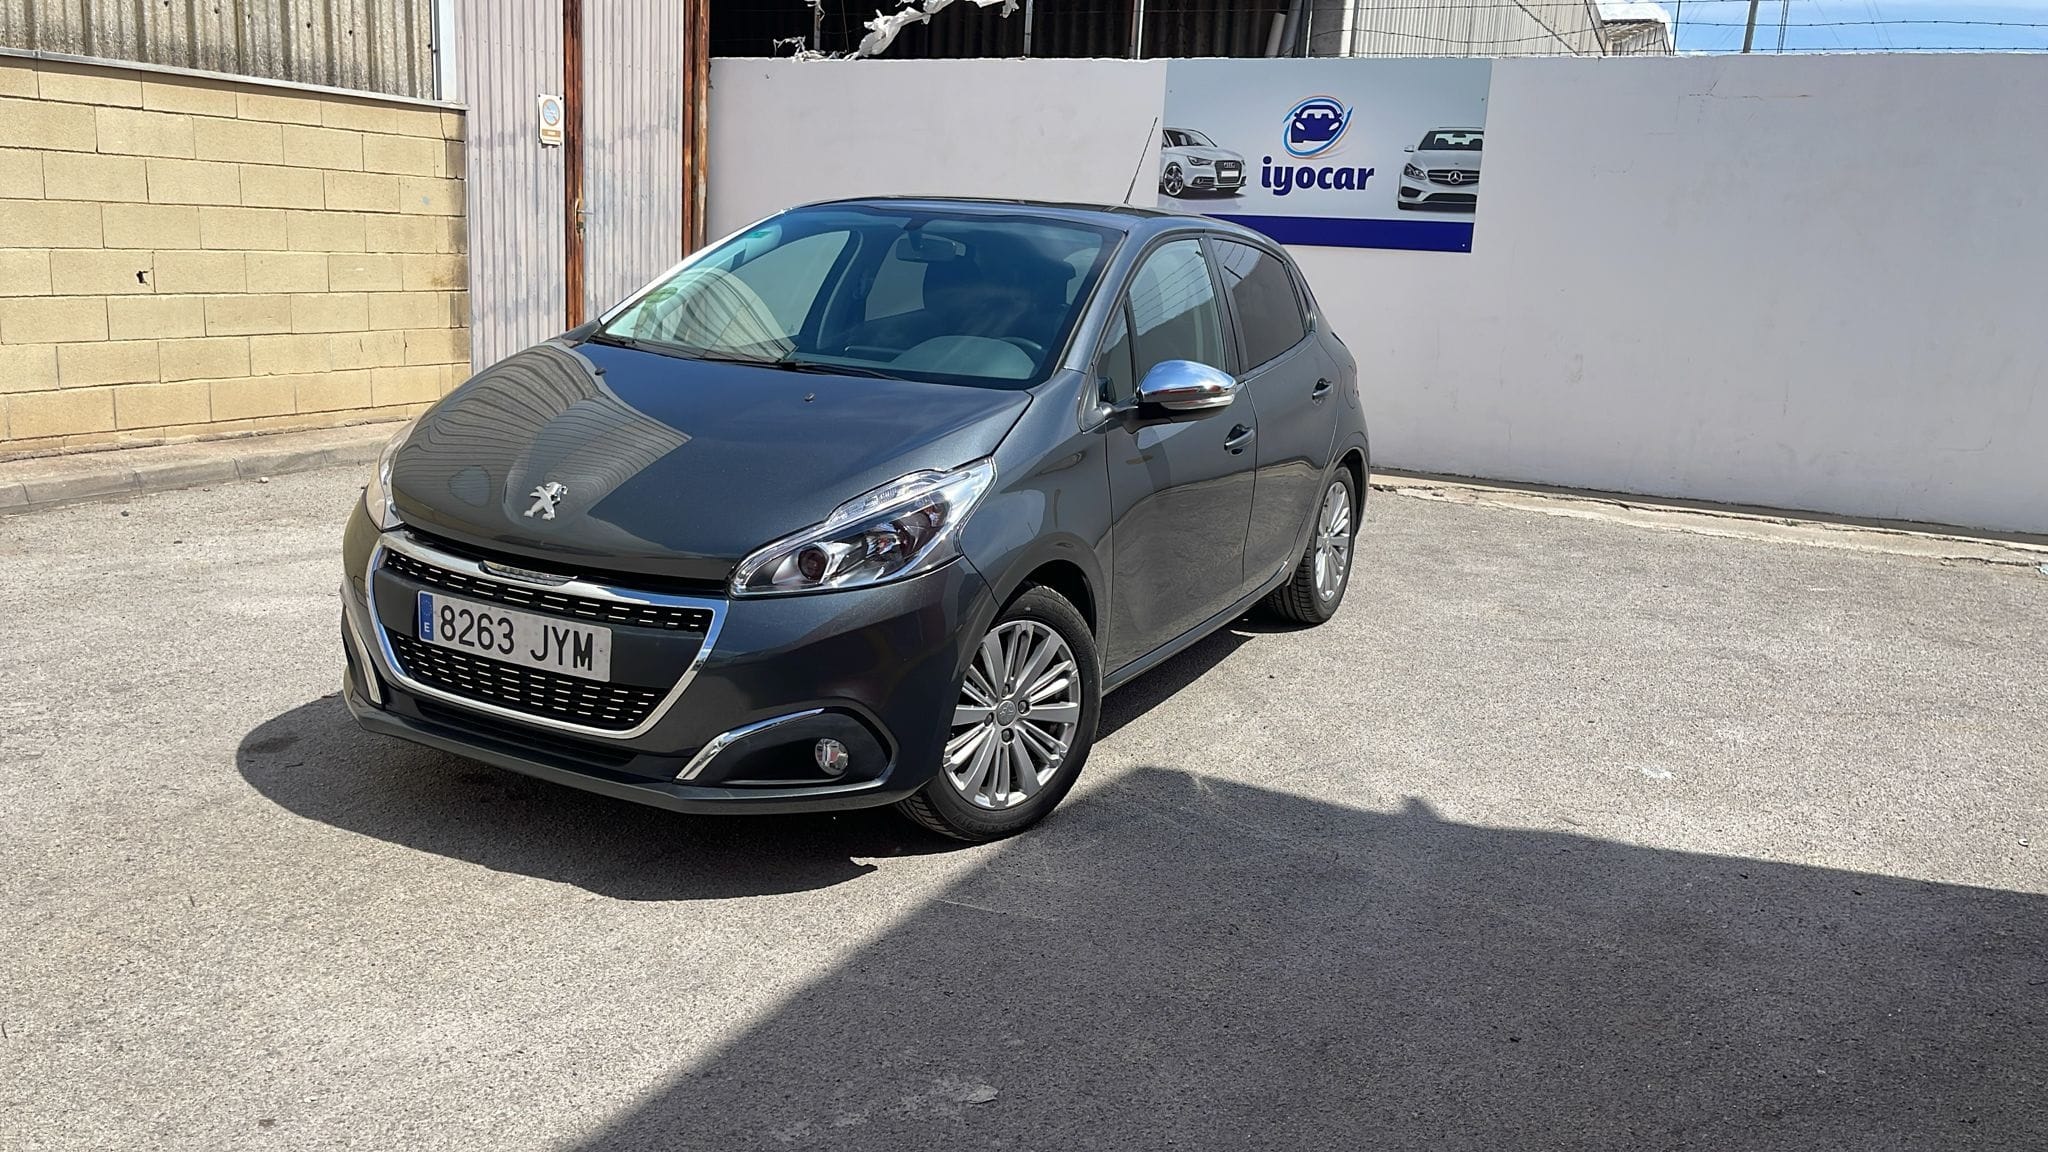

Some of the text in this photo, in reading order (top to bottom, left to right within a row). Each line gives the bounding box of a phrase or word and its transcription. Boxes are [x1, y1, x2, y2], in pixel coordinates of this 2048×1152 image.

[1261, 156, 1375, 196] iyocar
[424, 621, 431, 633] E
[440, 605, 593, 671] 8263 JYM
